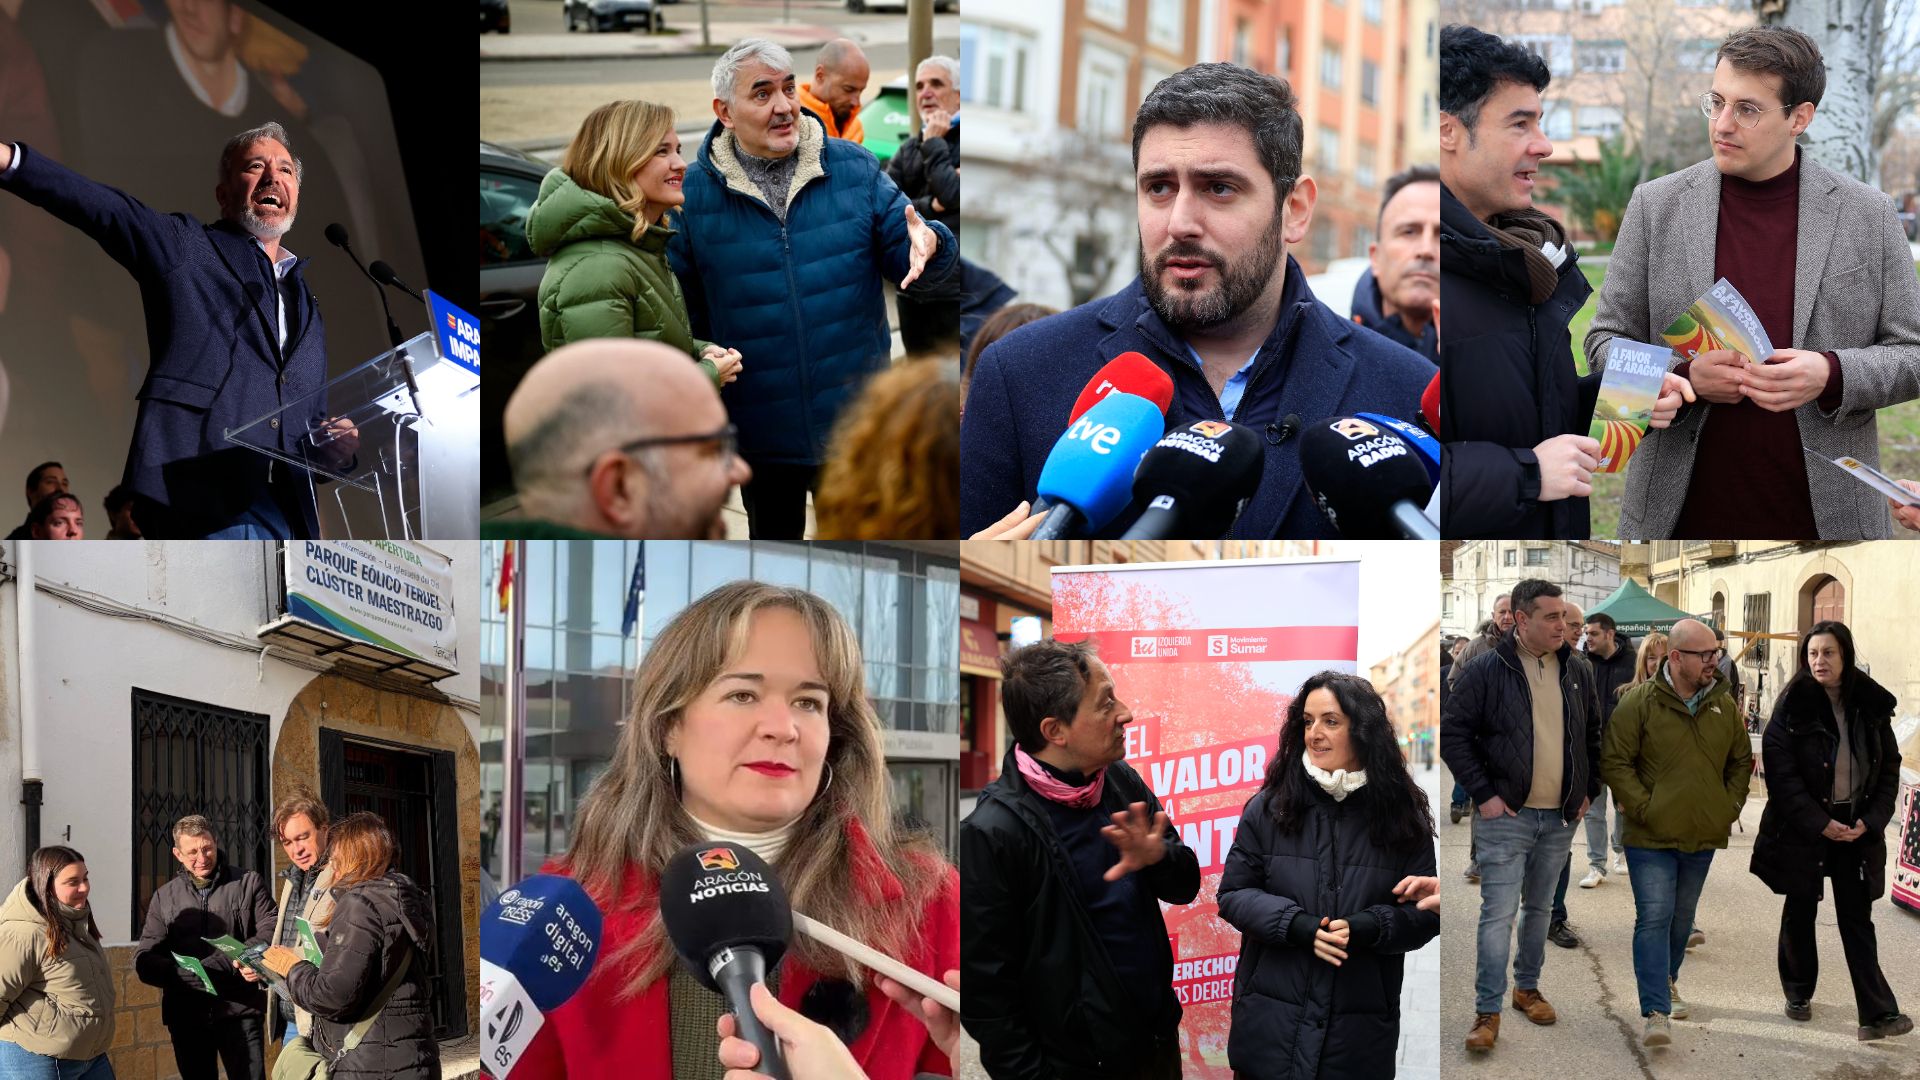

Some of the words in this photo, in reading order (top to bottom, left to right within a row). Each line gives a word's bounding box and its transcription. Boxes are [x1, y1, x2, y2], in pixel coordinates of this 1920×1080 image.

[1725, 291, 1758, 331] FAVOR
[1711, 290, 1728, 306] DE
[1727, 305, 1766, 356] ARAGÓN
[1611, 347, 1620, 359] A
[1620, 349, 1652, 366] FAVOR
[1608, 360, 1622, 372] DE
[1623, 362, 1665, 379] ARAGÓN
[1067, 415, 1121, 455] tve
[1167, 432, 1225, 454] ARAGÓN
[1156, 439, 1221, 463] NOTICIAS
[1347, 434, 1406, 461] ARAGÓN
[1358, 445, 1407, 468] RADIO
[305, 541, 358, 578] PARQUE
[361, 561, 402, 594] EÓLICO
[404, 582, 442, 611] TERUEL
[306, 565, 364, 602] CLÚSTER
[367, 589, 443, 632] MAESTRAZGO
[1616, 623, 1651, 633] española
[1158, 636, 1192, 647] IZQUIERDA
[1230, 636, 1268, 644] Movimiento
[1230, 643, 1268, 655] Sumar
[1158, 647, 1179, 657] UNIDA
[1124, 724, 1153, 760] EL
[1151, 744, 1266, 798] VALOR
[693, 870, 762, 890] ARAGÓN
[690, 882, 770, 903] NOTICIAS
[501, 906, 535, 923] PRESS
[555, 903, 594, 953] aragon
[545, 922, 585, 970] digital
[1193, 979, 1234, 1003] DEREC
